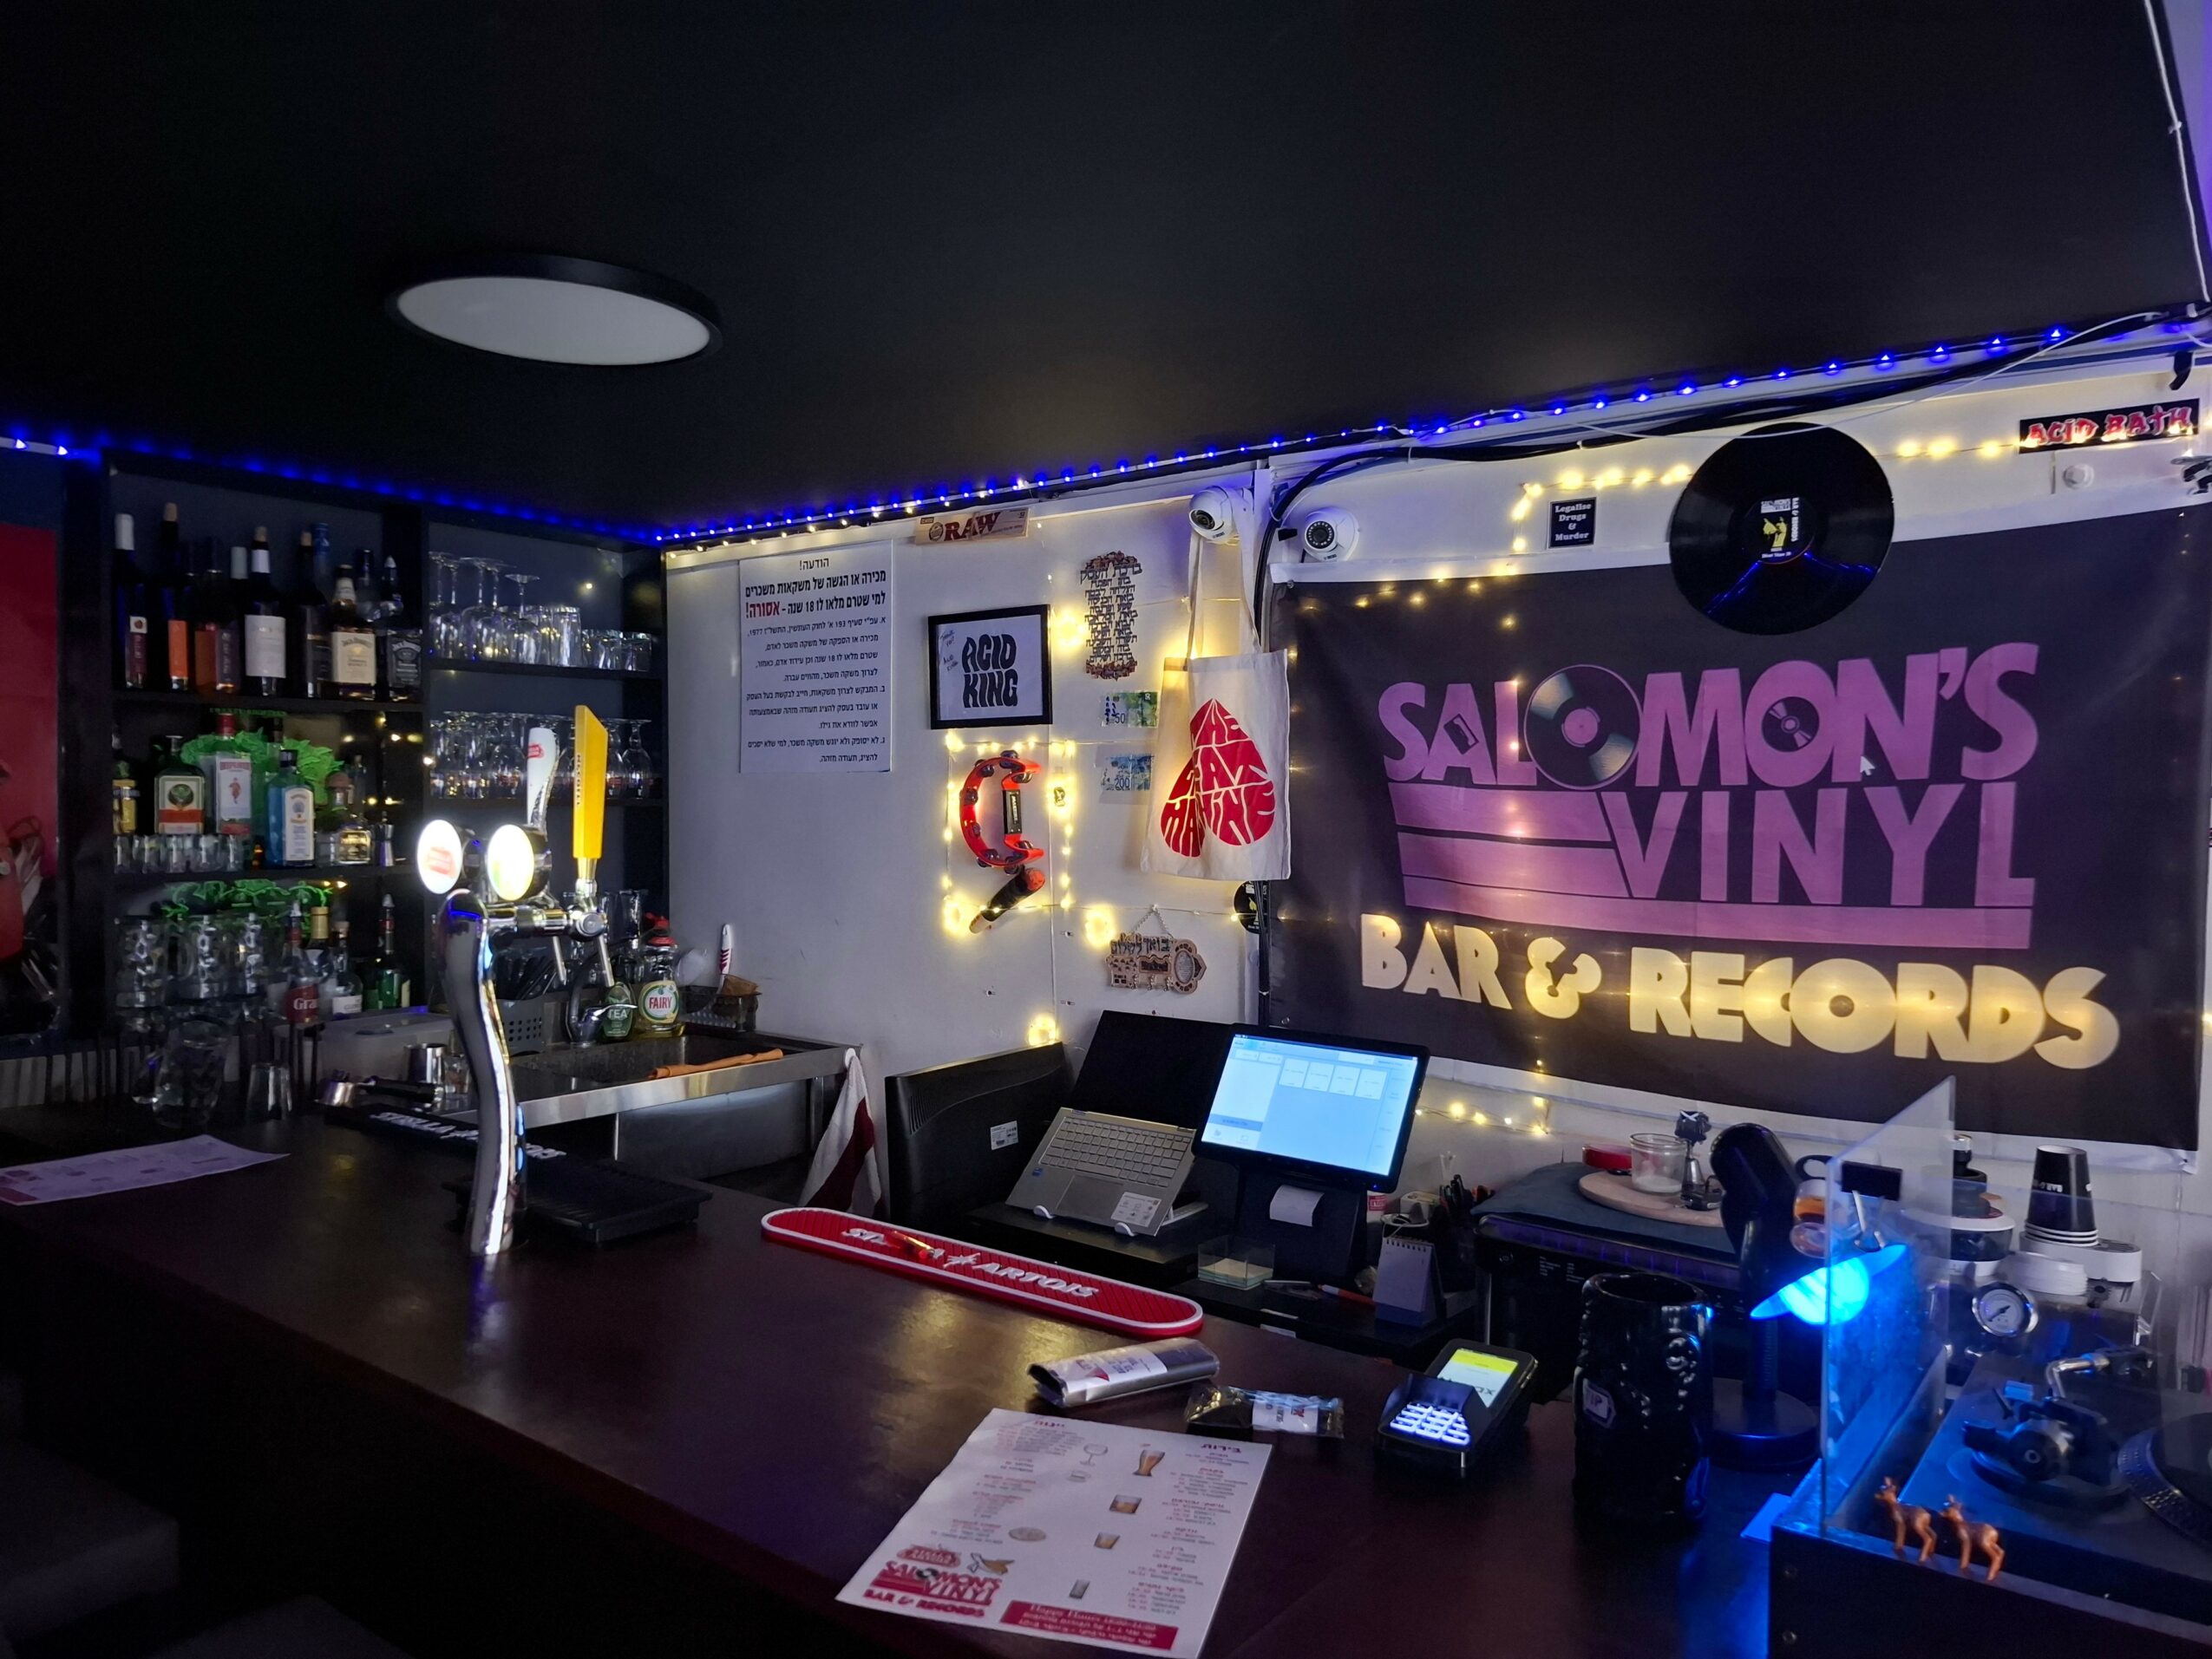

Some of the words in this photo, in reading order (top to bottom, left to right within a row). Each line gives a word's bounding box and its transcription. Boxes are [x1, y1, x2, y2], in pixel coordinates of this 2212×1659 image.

[2028, 419, 2098, 445] ACID
[2104, 405, 2193, 440] BATH
[1554, 504, 1592, 513] Legalise
[943, 512, 1002, 541] RAW
[1554, 532, 1589, 541] Murder
[800, 558, 828, 570] הודעה!
[1113, 562, 1142, 578] ברכת
[813, 577, 824, 590] של
[827, 575, 848, 587] הגשה
[851, 573, 860, 585] או
[862, 570, 886, 584] מכירה
[1080, 569, 1108, 585] העסק
[746, 584, 775, 597] משכרים
[777, 579, 810, 594] משקאות
[826, 597, 844, 610] מלאו
[847, 594, 870, 608] שטרם
[872, 591, 886, 604] למי
[746, 601, 780, 618] אסורה!
[788, 602, 802, 614] שנה
[806, 600, 814, 612] 18
[816, 598, 824, 611] לו
[812, 622, 826, 631] לחוק
[847, 618, 863, 629] סעיף
[800, 640, 817, 649] משקה
[829, 637, 850, 647] הספקה
[962, 634, 1017, 673] ACID
[841, 669, 859, 680] משקה
[861, 668, 877, 679] לצרוך
[837, 687, 853, 697] לצרוך
[855, 686, 878, 696] המבקש
[963, 669, 1018, 708] KING
[1115, 713, 1126, 723] 50
[1378, 642, 2039, 790] SALOMON'S
[807, 740, 825, 748] משקה
[1115, 777, 1130, 788] 200
[1599, 782, 2035, 906] VINYL
[1360, 913, 1512, 1009] BAR
[1525, 937, 1601, 1019] &
[1630, 946, 2119, 1070] RECORDS
[649, 996, 671, 1009] FAIRY
[972, 1262, 1099, 1297] ARTOIS
